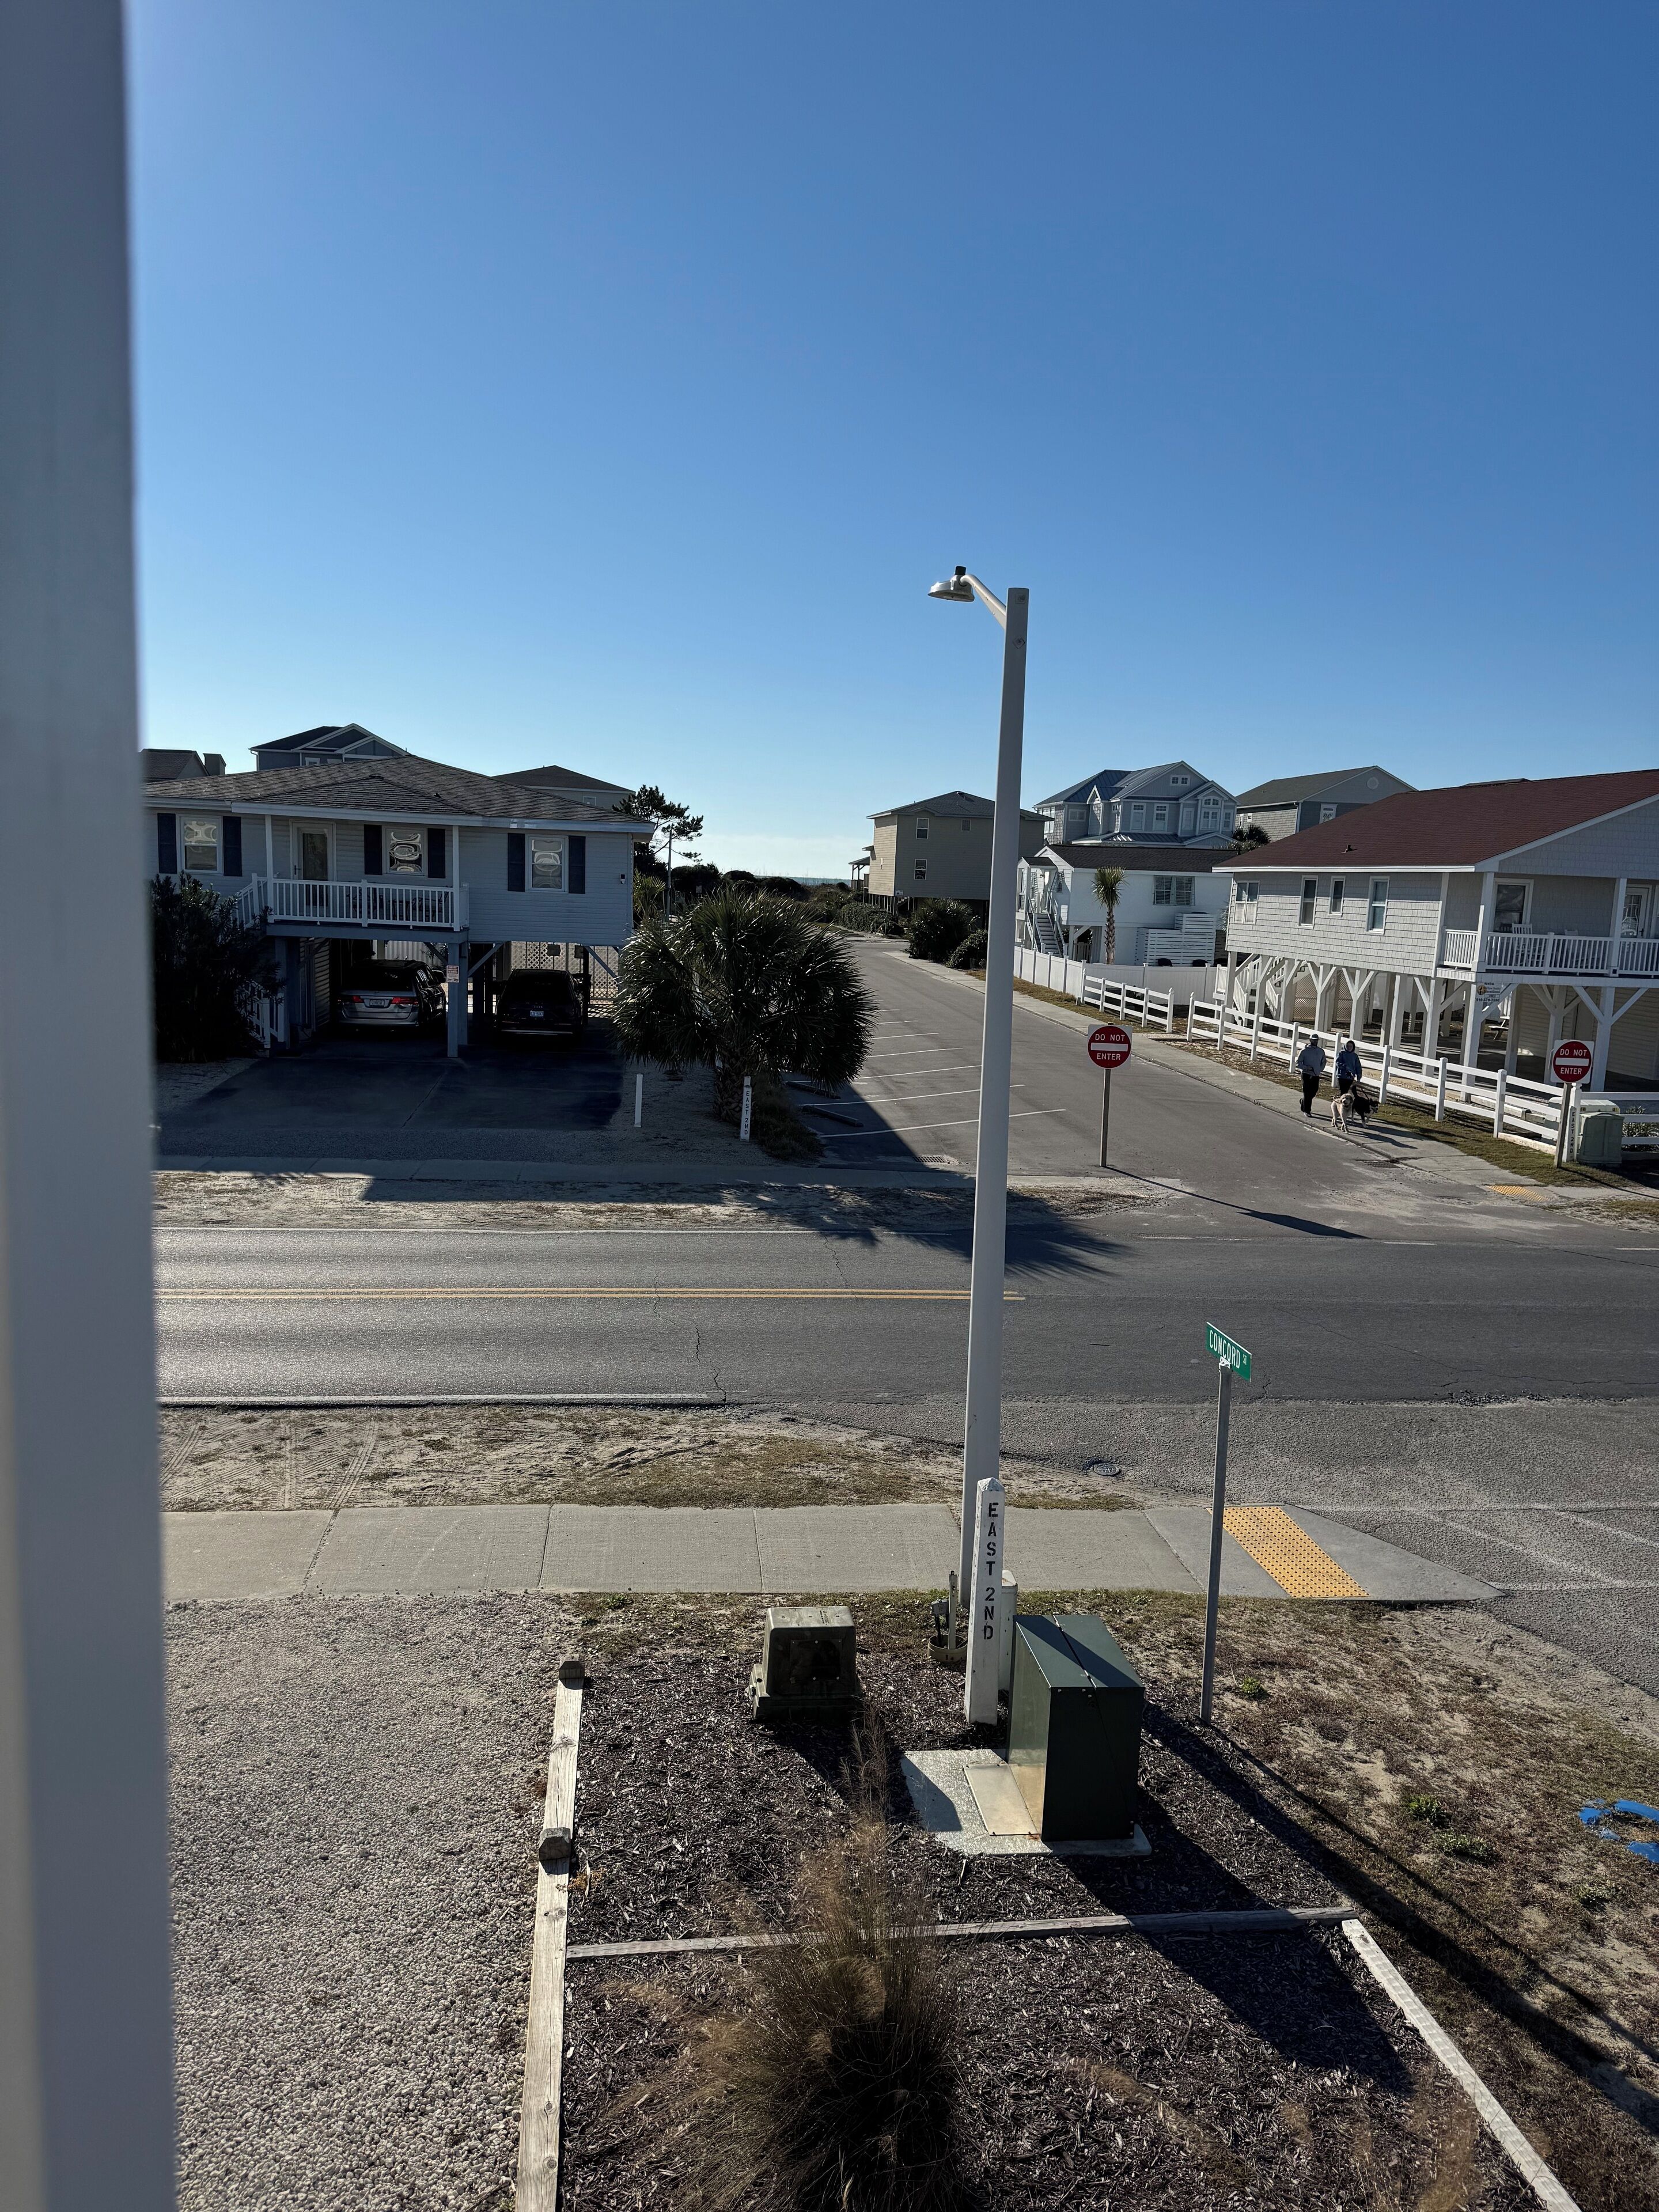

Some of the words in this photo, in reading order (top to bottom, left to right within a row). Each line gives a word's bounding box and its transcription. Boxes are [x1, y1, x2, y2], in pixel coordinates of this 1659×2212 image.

[1210, 1330, 1240, 1369] CONCORD
[1243, 1354, 1247, 1365] ST
[986, 1502, 999, 1575] EAST
[983, 1587, 995, 1640] 2ND
